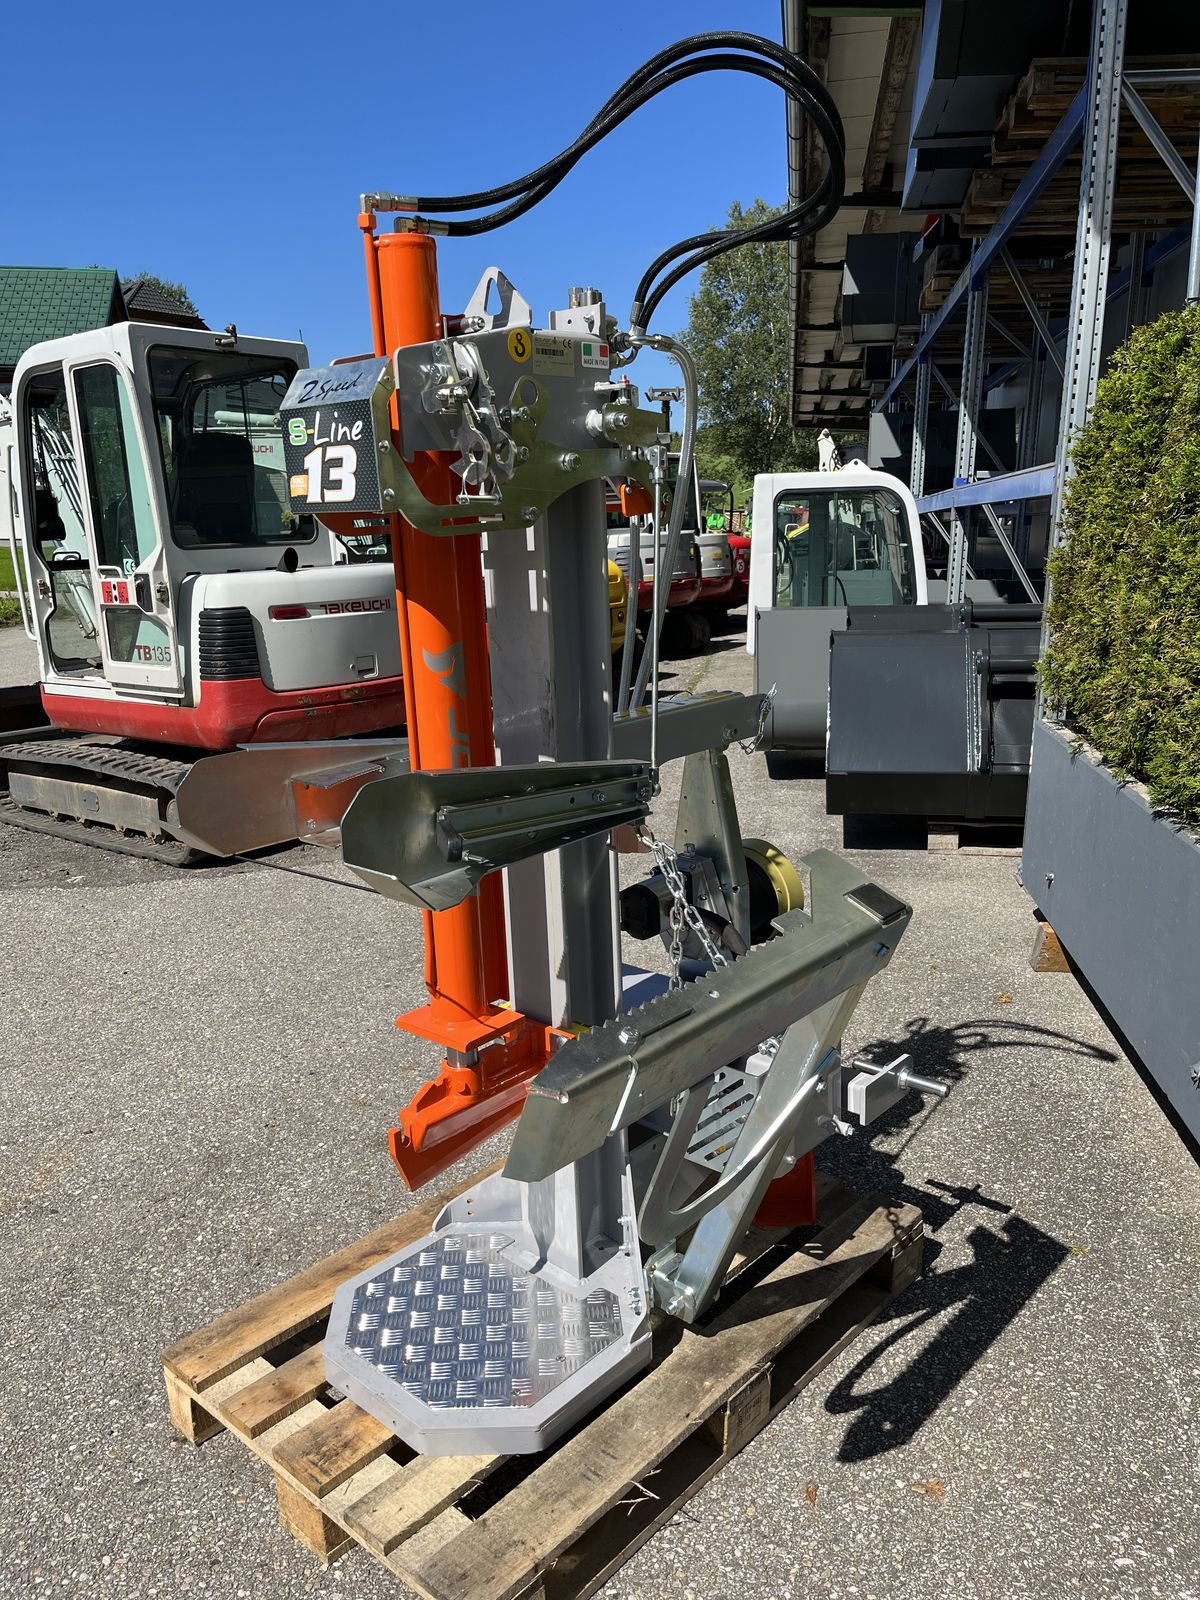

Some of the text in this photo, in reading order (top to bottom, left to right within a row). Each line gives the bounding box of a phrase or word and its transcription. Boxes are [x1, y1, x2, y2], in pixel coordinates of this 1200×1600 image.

[583, 358, 594, 366] MADE
[298, 380, 319, 403] 2
[303, 445, 357, 504] 13
[320, 599, 391, 615] TAKEUCHI
